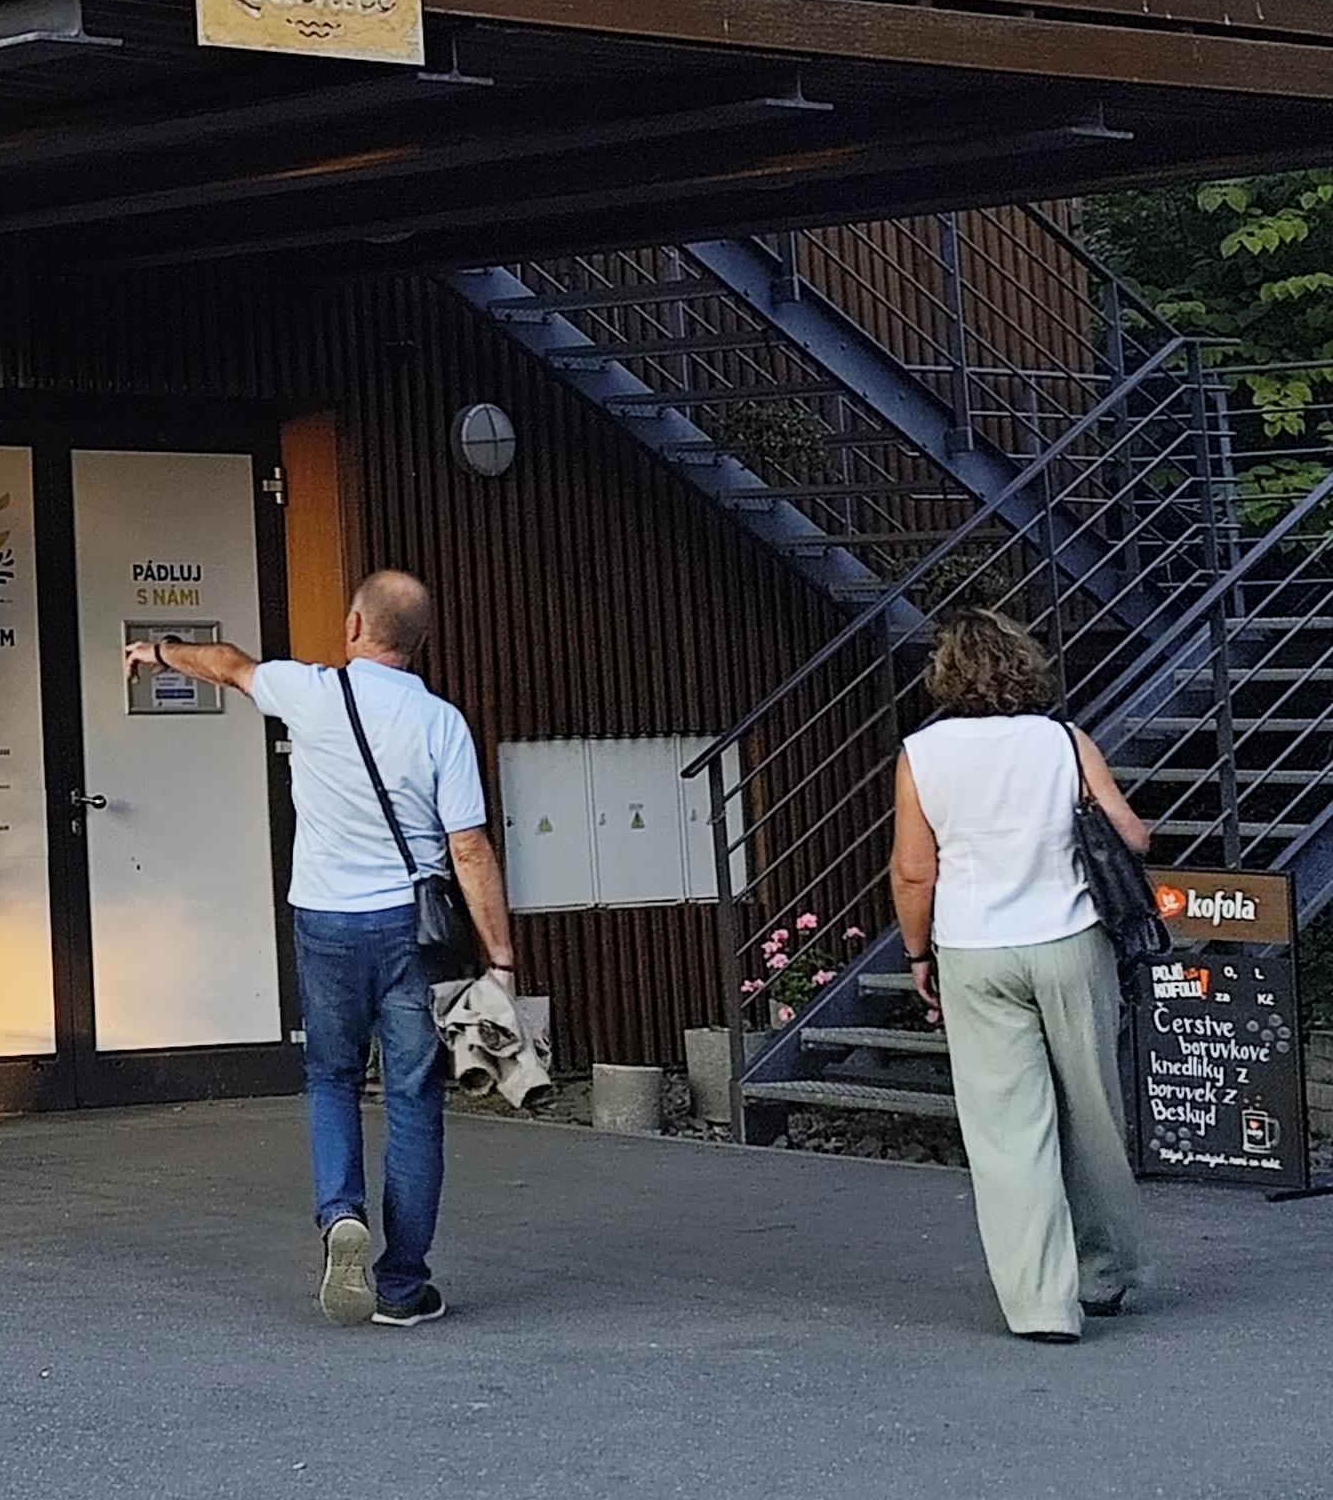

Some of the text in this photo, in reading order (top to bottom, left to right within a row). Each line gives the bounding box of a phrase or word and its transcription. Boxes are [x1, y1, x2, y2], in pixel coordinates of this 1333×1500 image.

[132, 560, 202, 581] PÁDLUJ
[136, 585, 200, 606] S NÁMI
[1187, 889, 1256, 926] kofola
[1147, 1075, 1218, 1104] boruvek
[1150, 1098, 1217, 1137] Beskyd
